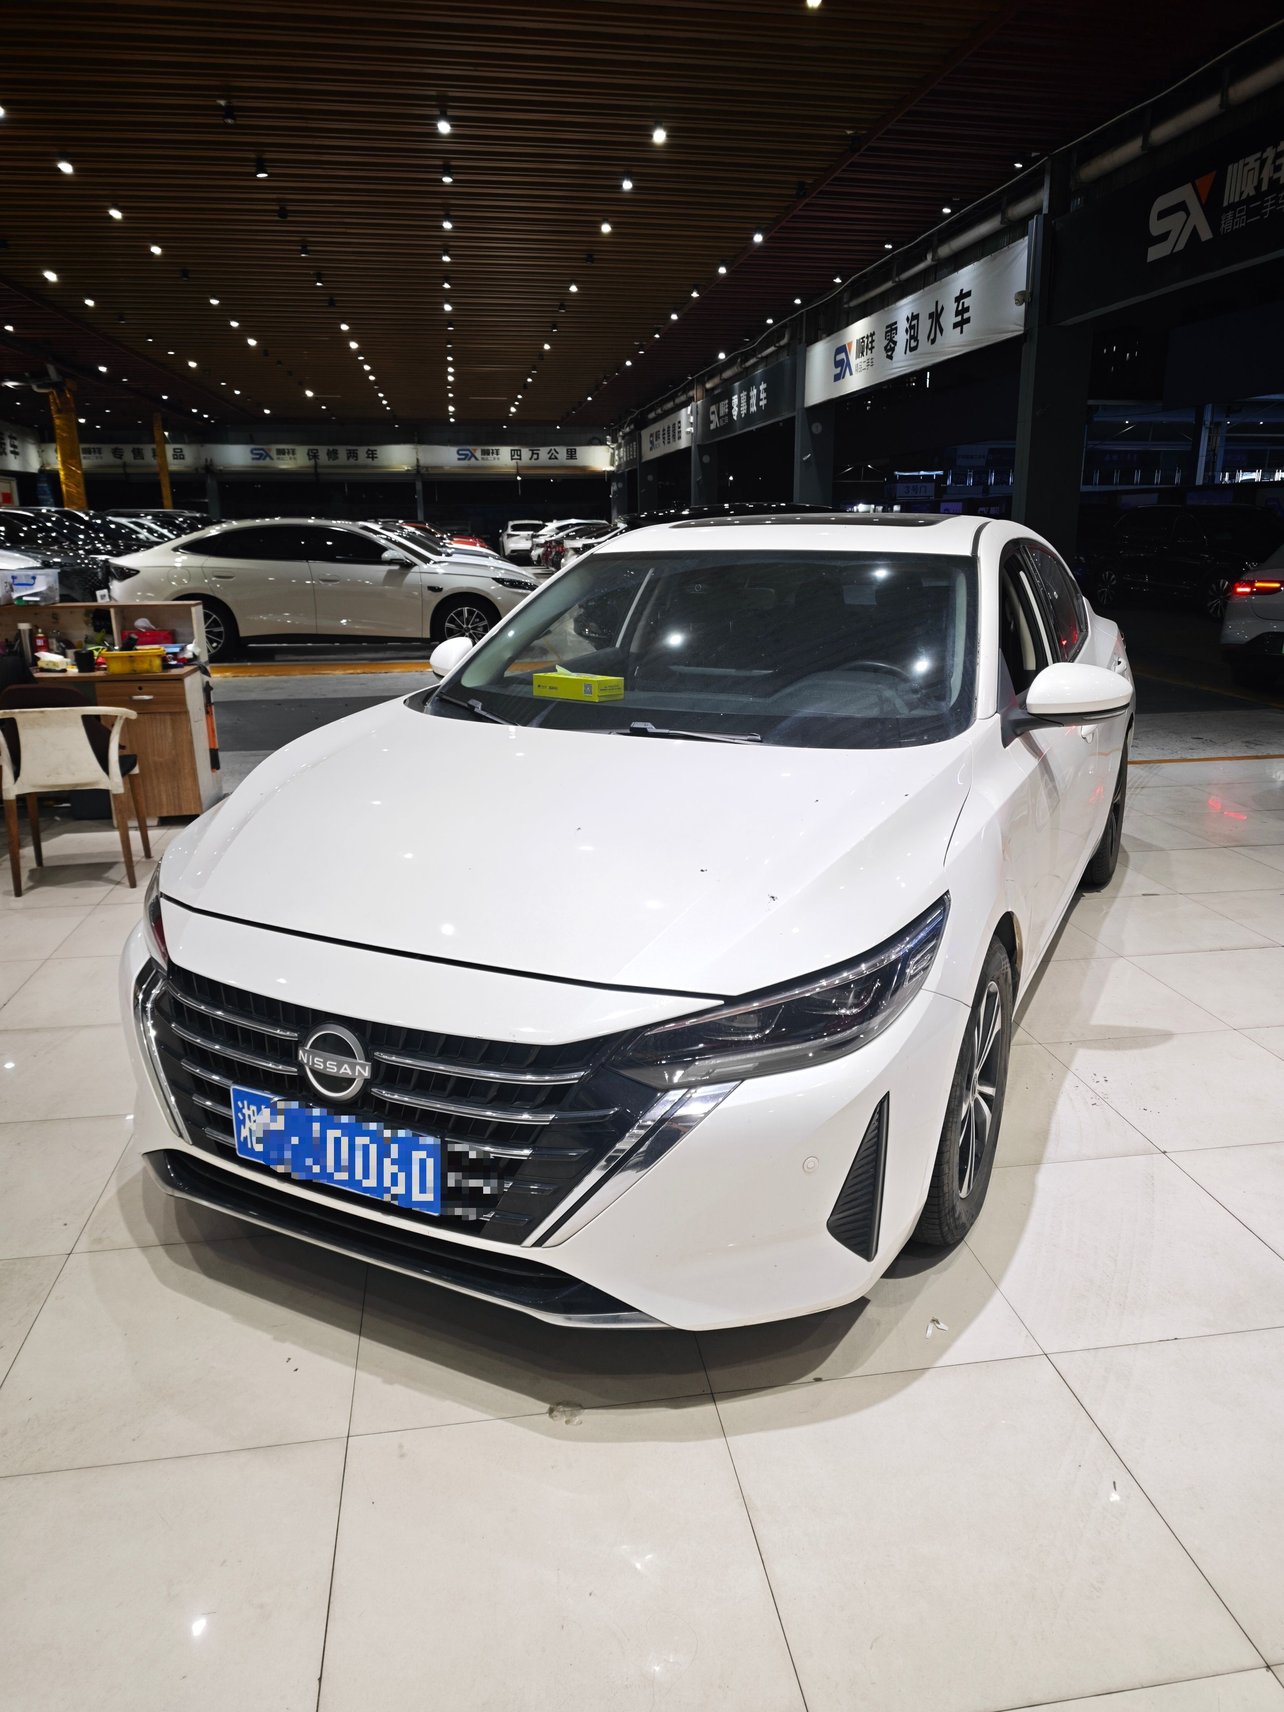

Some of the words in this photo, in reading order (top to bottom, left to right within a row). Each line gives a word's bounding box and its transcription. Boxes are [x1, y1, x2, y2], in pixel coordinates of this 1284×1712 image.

[884, 288, 972, 361] 零泡水车
[855, 331, 875, 360] 顺祥
[307, 448, 378, 461] 保修两年
[510, 448, 578, 461] 四万公里
[299, 1050, 370, 1077] NISSAN
